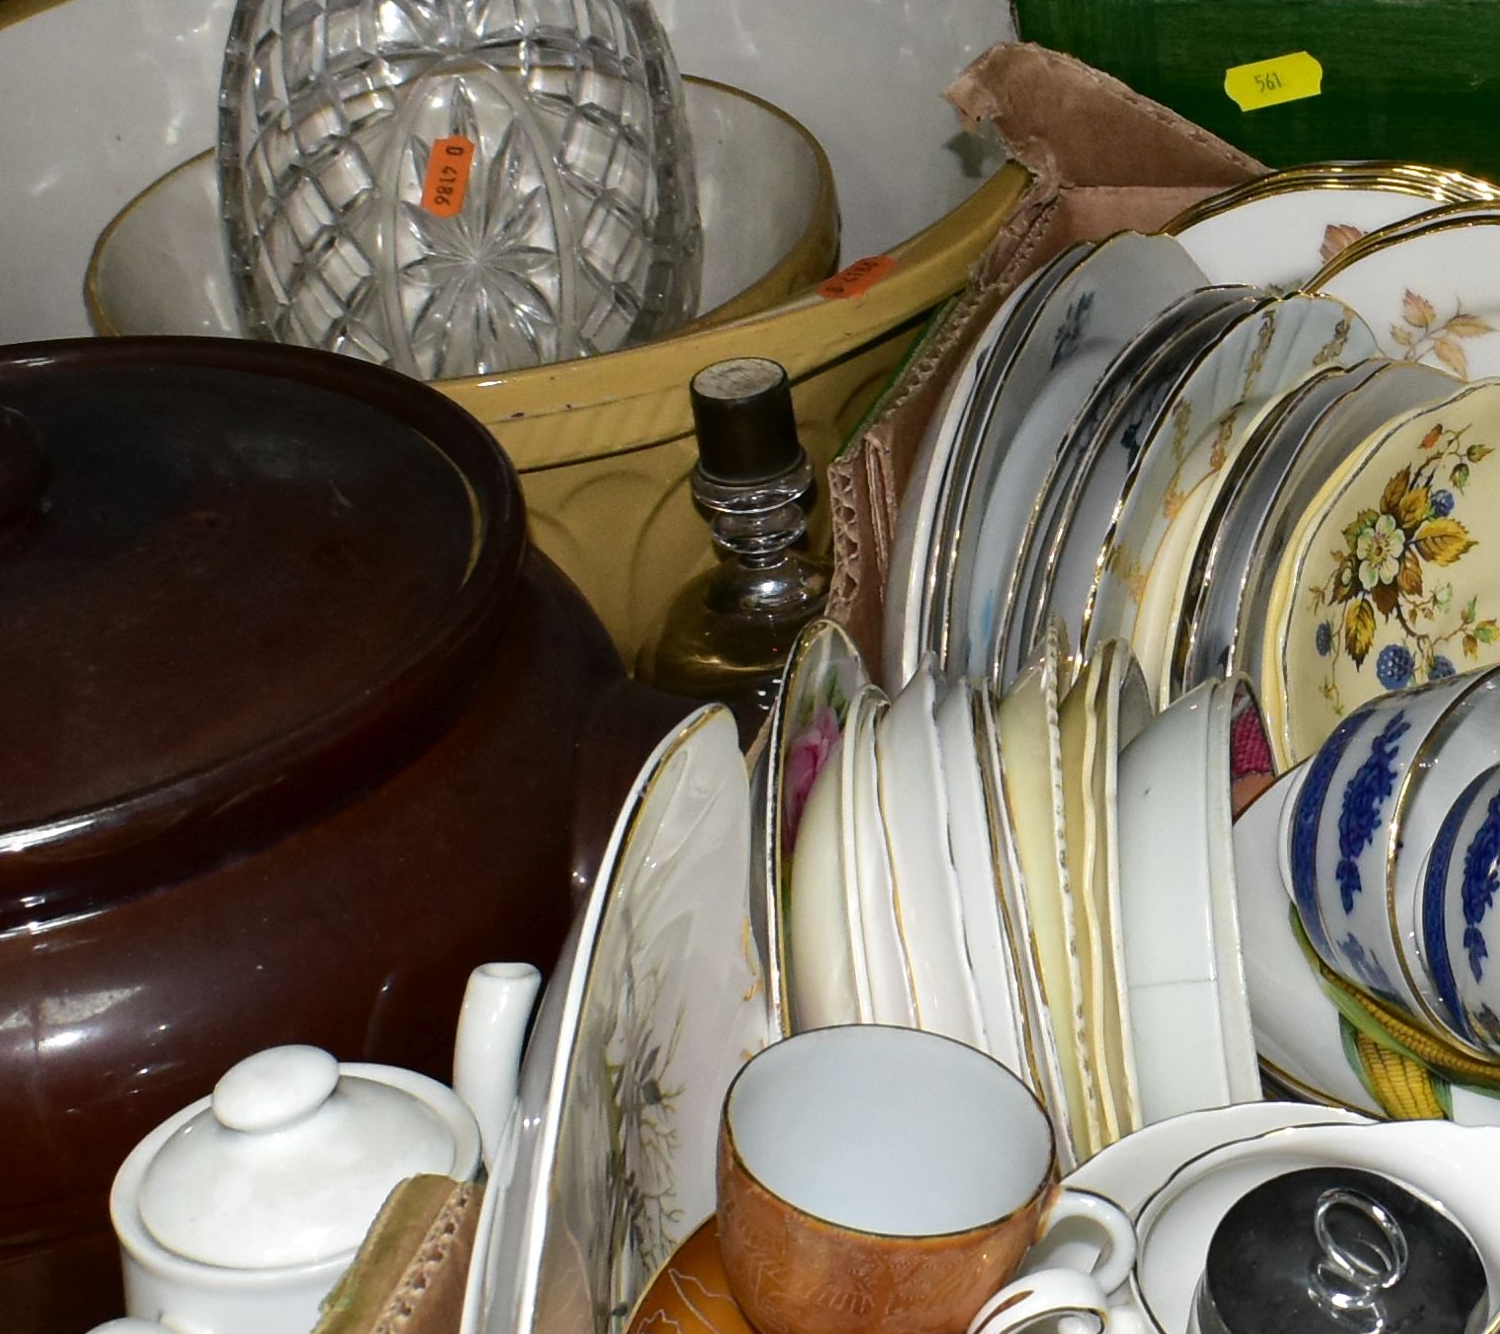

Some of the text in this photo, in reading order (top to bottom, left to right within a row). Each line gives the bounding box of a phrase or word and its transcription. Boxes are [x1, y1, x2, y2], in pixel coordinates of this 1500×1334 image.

[1253, 72, 1282, 93] 561
[434, 146, 464, 206] D 4186
